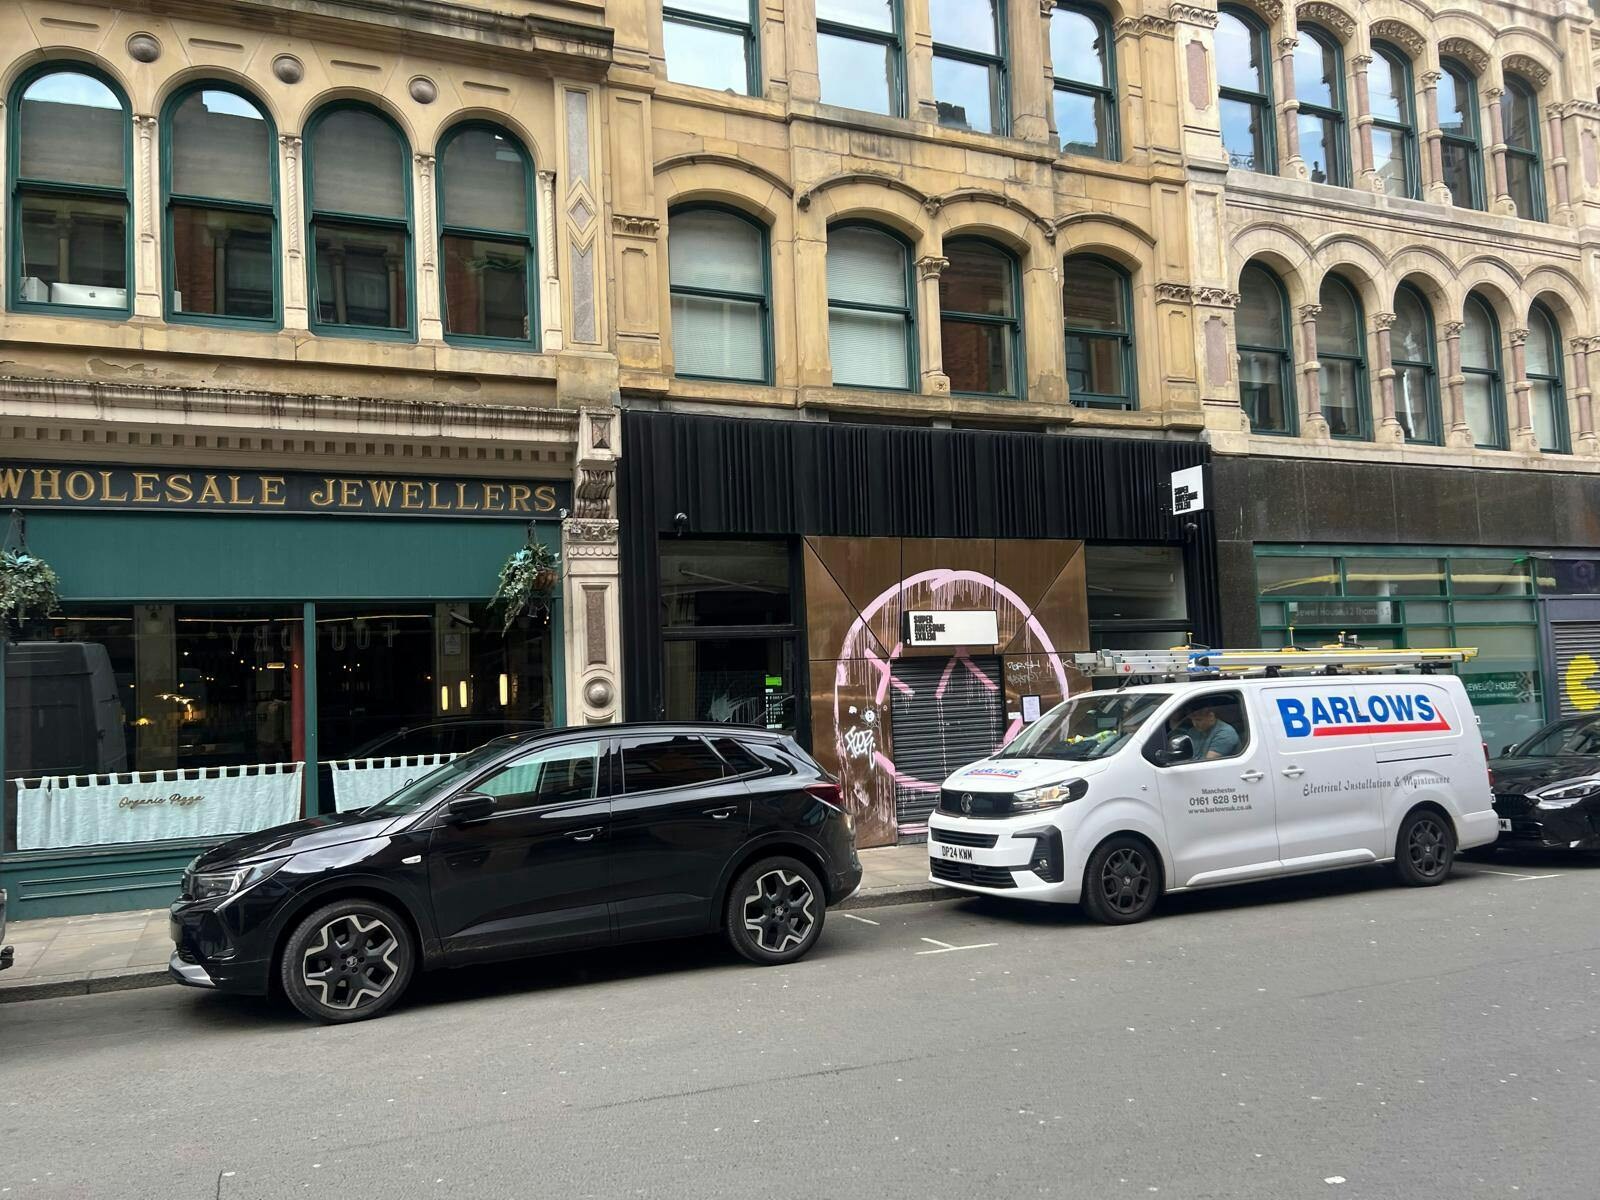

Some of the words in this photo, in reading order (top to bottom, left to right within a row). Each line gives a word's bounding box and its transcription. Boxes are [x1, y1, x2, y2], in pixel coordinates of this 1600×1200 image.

[0, 467, 286, 505] WHOLESALE
[309, 478, 556, 512] JEWELLERS
[1276, 694, 1435, 737] BARLOWS
[1303, 781, 1342, 797] Electrical
[1344, 778, 1391, 791] Installation
[119, 797, 166, 809] Organic
[1190, 796, 1209, 806] 0161
[1213, 795, 1230, 804] 628
[1232, 794, 1249, 803] 9111
[942, 845, 958, 858] DP24
[959, 848, 973, 860] KWM
